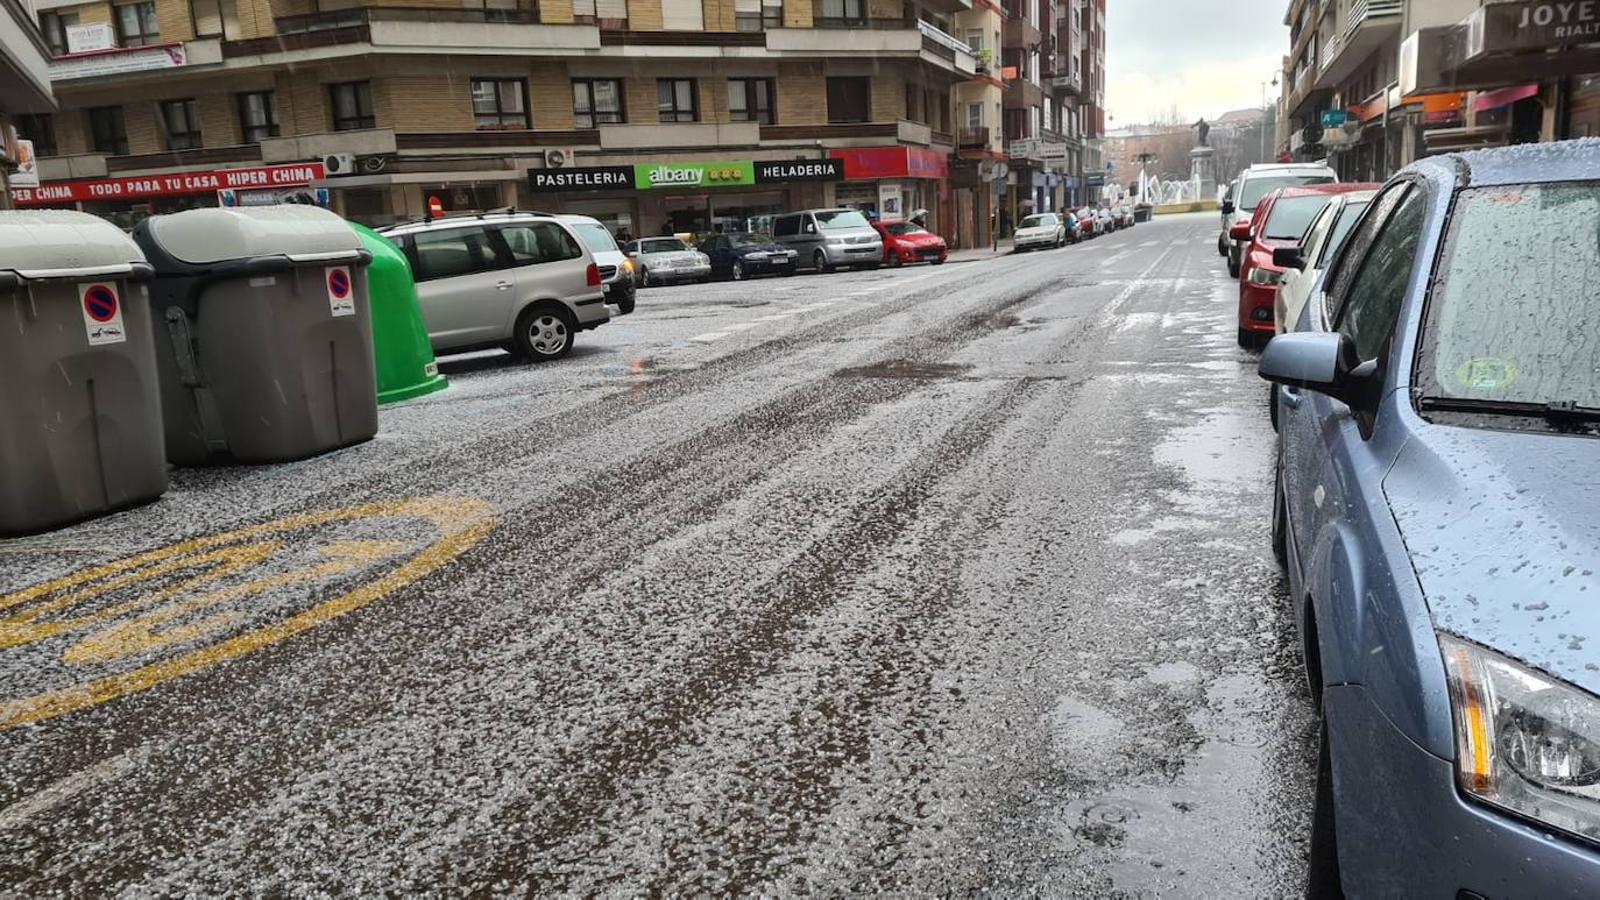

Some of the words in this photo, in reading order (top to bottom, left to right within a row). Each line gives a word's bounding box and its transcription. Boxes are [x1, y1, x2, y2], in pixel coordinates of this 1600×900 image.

[1518, 1, 1595, 29] JOYE
[226, 170, 267, 186] HIPER
[272, 167, 315, 183] CHINA
[537, 172, 627, 186] PASTELERIA
[649, 166, 704, 186] albany
[763, 164, 836, 177] HELADERIA
[35, 186, 72, 200] CHINA
[89, 183, 121, 196] TODO
[127, 180, 160, 193] PARA
[165, 178, 181, 190] TU
[185, 175, 219, 188] CASA
